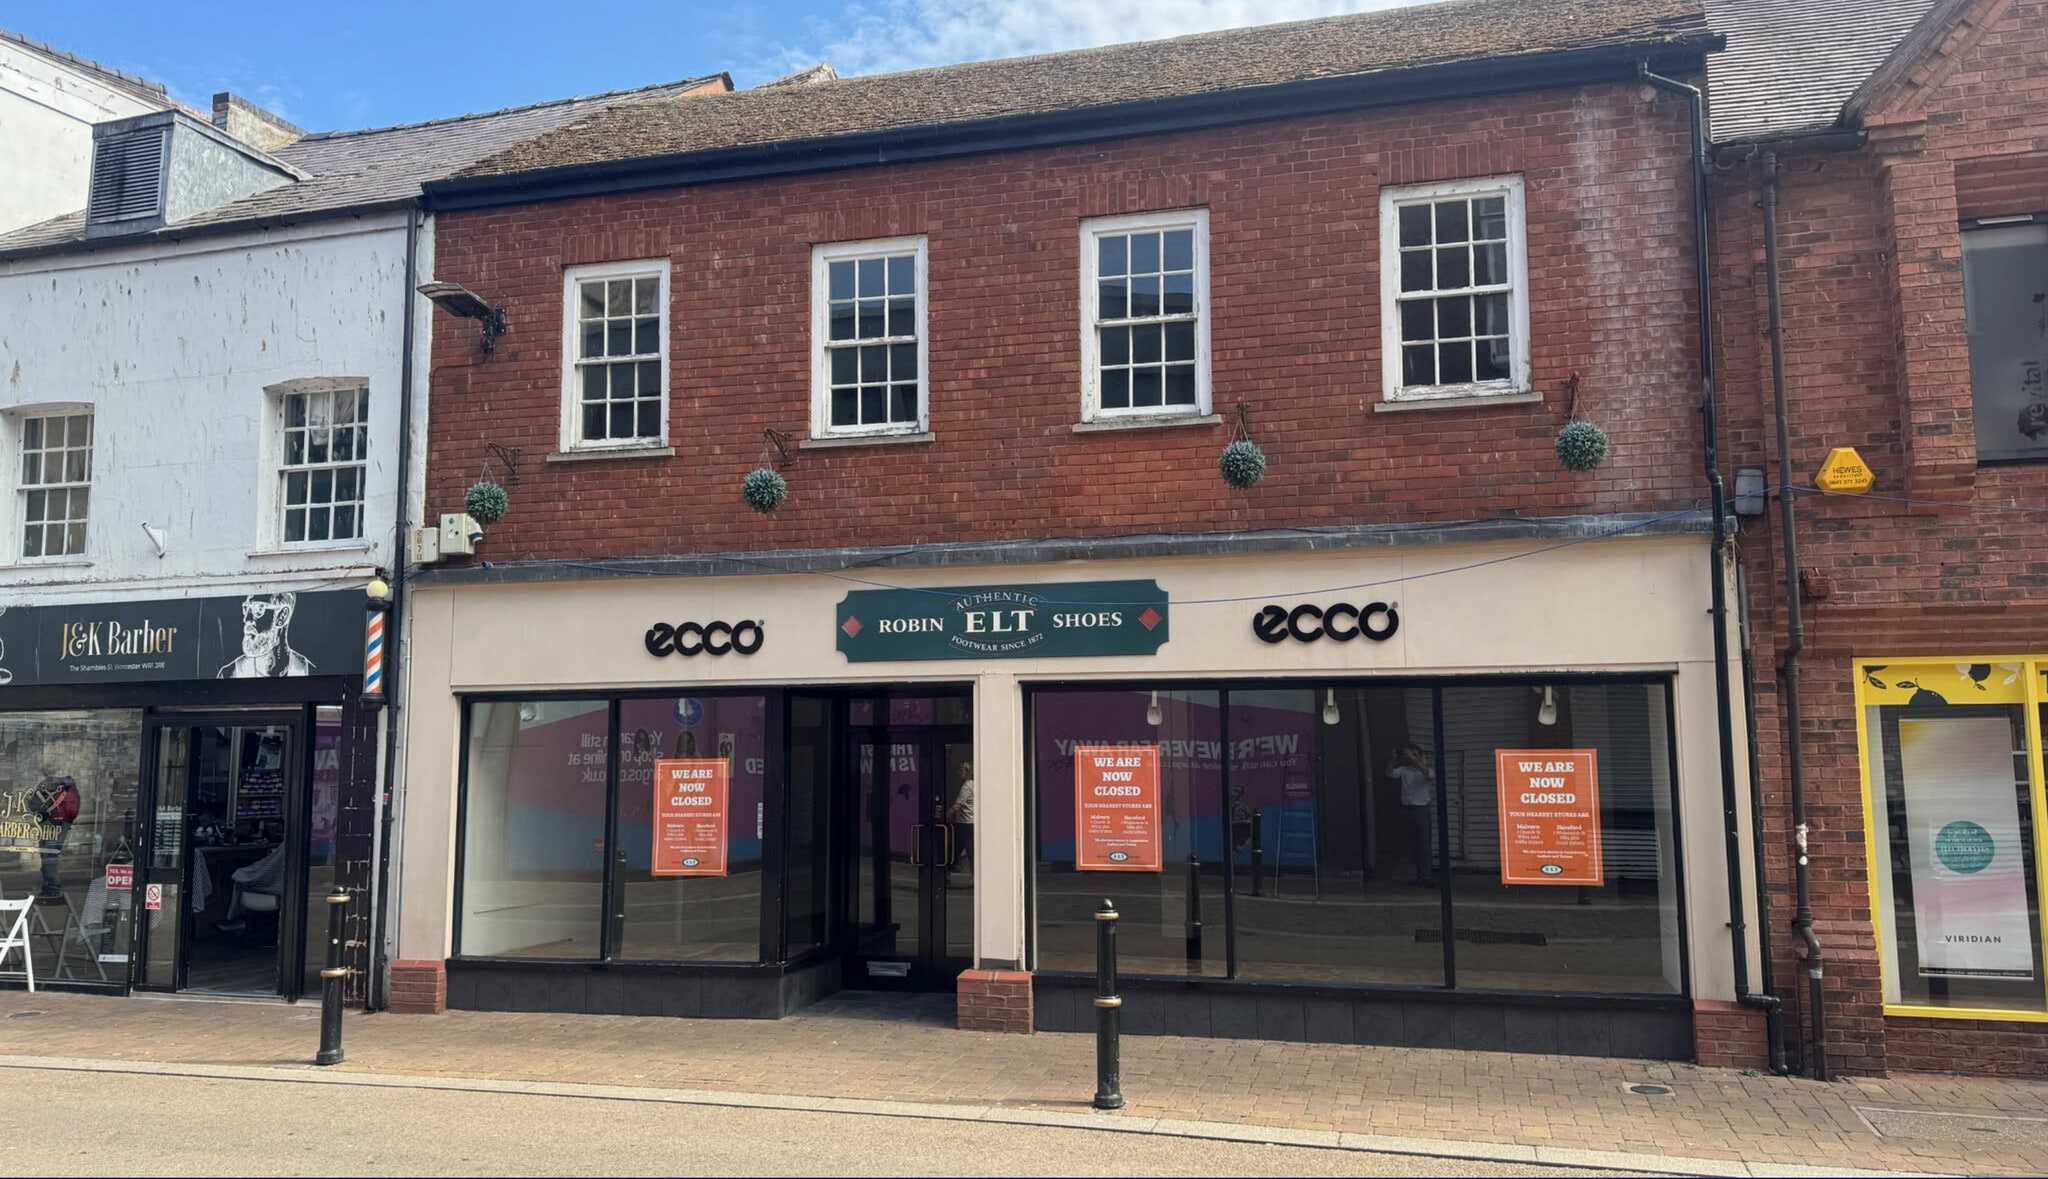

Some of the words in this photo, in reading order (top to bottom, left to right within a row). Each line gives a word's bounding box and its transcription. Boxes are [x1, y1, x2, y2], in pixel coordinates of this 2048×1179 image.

[1833, 466, 1862, 474] HEWES
[956, 591, 1038, 611] AUTHENTIC
[879, 618, 944, 633] ROBIN
[965, 610, 1034, 633] ELT
[1053, 612, 1123, 628] SHOES
[1253, 602, 1399, 643] ecco
[60, 622, 103, 661] J&K
[107, 619, 178, 655] Barber
[645, 620, 763, 657] ecco
[951, 635, 998, 651] FOOTWEAR
[1001, 640, 1026, 651] SINCE
[1094, 757, 1114, 767] WE
[1116, 757, 1141, 767] ARE
[1518, 762, 1543, 772] WE
[1545, 762, 1574, 772] ARE
[672, 769, 690, 779] WE
[691, 769, 713, 779] ARE
[1102, 771, 1133, 782] NOW
[679, 783, 705, 792] NOW
[1529, 777, 1565, 788] NOW
[1094, 786, 1141, 796] CLOSED
[1, 788, 34, 819] J&K
[671, 796, 712, 806] CLOSED
[1520, 793, 1576, 804] CLOSED
[1945, 935, 2002, 943] VIRIDIAN
